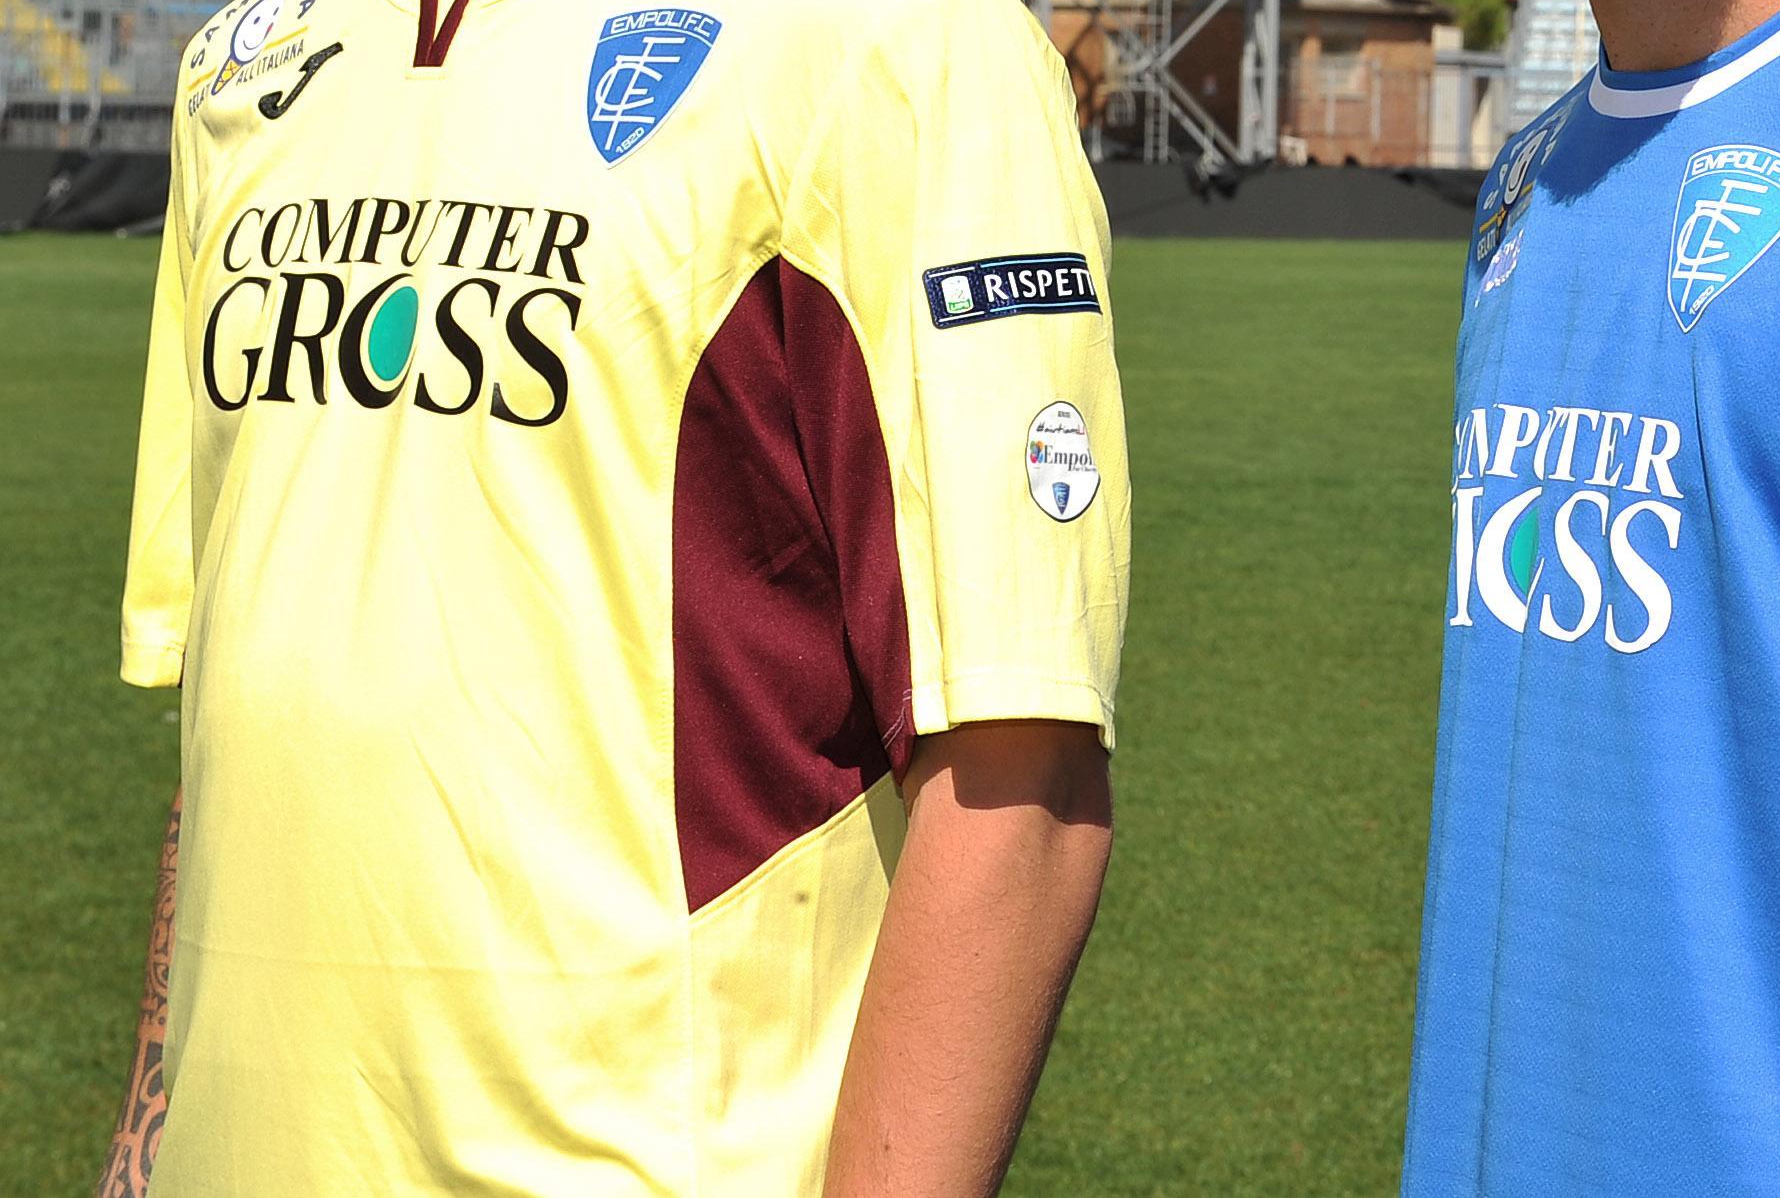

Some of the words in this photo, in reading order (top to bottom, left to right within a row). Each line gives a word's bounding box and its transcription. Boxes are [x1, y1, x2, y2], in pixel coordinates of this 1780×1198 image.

[610, 10, 688, 34] EMPOLI
[1691, 150, 1772, 176] EMPOLI
[223, 197, 590, 285] COMPUTER
[983, 268, 1095, 303] RISPETT
[202, 272, 583, 428] GROSS
